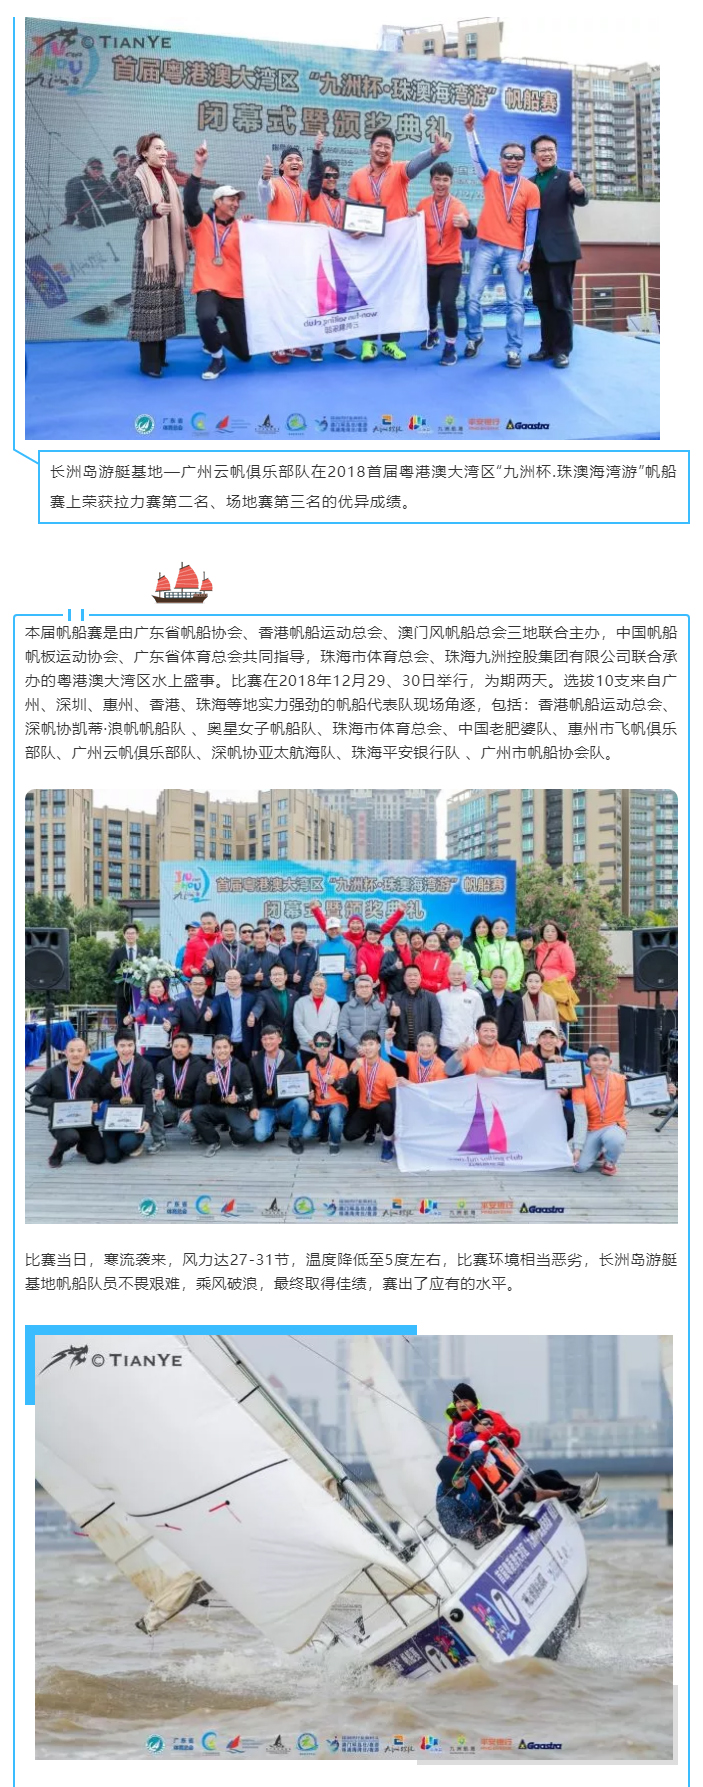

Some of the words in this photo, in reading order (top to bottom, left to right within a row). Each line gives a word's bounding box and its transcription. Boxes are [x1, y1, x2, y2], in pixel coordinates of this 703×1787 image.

[197, 100, 452, 144] 闭幕式暨颁奖典礼
[50, 495, 408, 510] 赛上荣获拉力赛第二名、场地赛第三名的优异成绩。
[25, 626, 678, 641] 本届帆船赛是由广东省帆船协会、香港帆船运动总会、澳门风帆船总会三地联合主办，中国帆船
[25, 650, 678, 665] 帆板运动协会、广东省体育总会共同指导，珠海市体育总会、珠海九洲控股集团有限公司联合承
[25, 673, 678, 688] 办的粤港澳大湾区水上盛事。比赛在2018年12月29、30日举行，为期两天。选拔10支来自广
[25, 697, 668, 712] 州、深圳、惠州、香港、珠海等地实力强劲的帆船代表队现场角逐，包括：香港帆船运动总会、
[25, 1252, 678, 1268] 比赛当日，寒流袭来，风力达27-31节，温度降低至5度左右，比赛环境相当恶劣，长洲岛游艇
[25, 1276, 513, 1291] 基地帆船队员不畏艰难，乘风破浪，最终取得佳绩，赛出了应有的水平。
